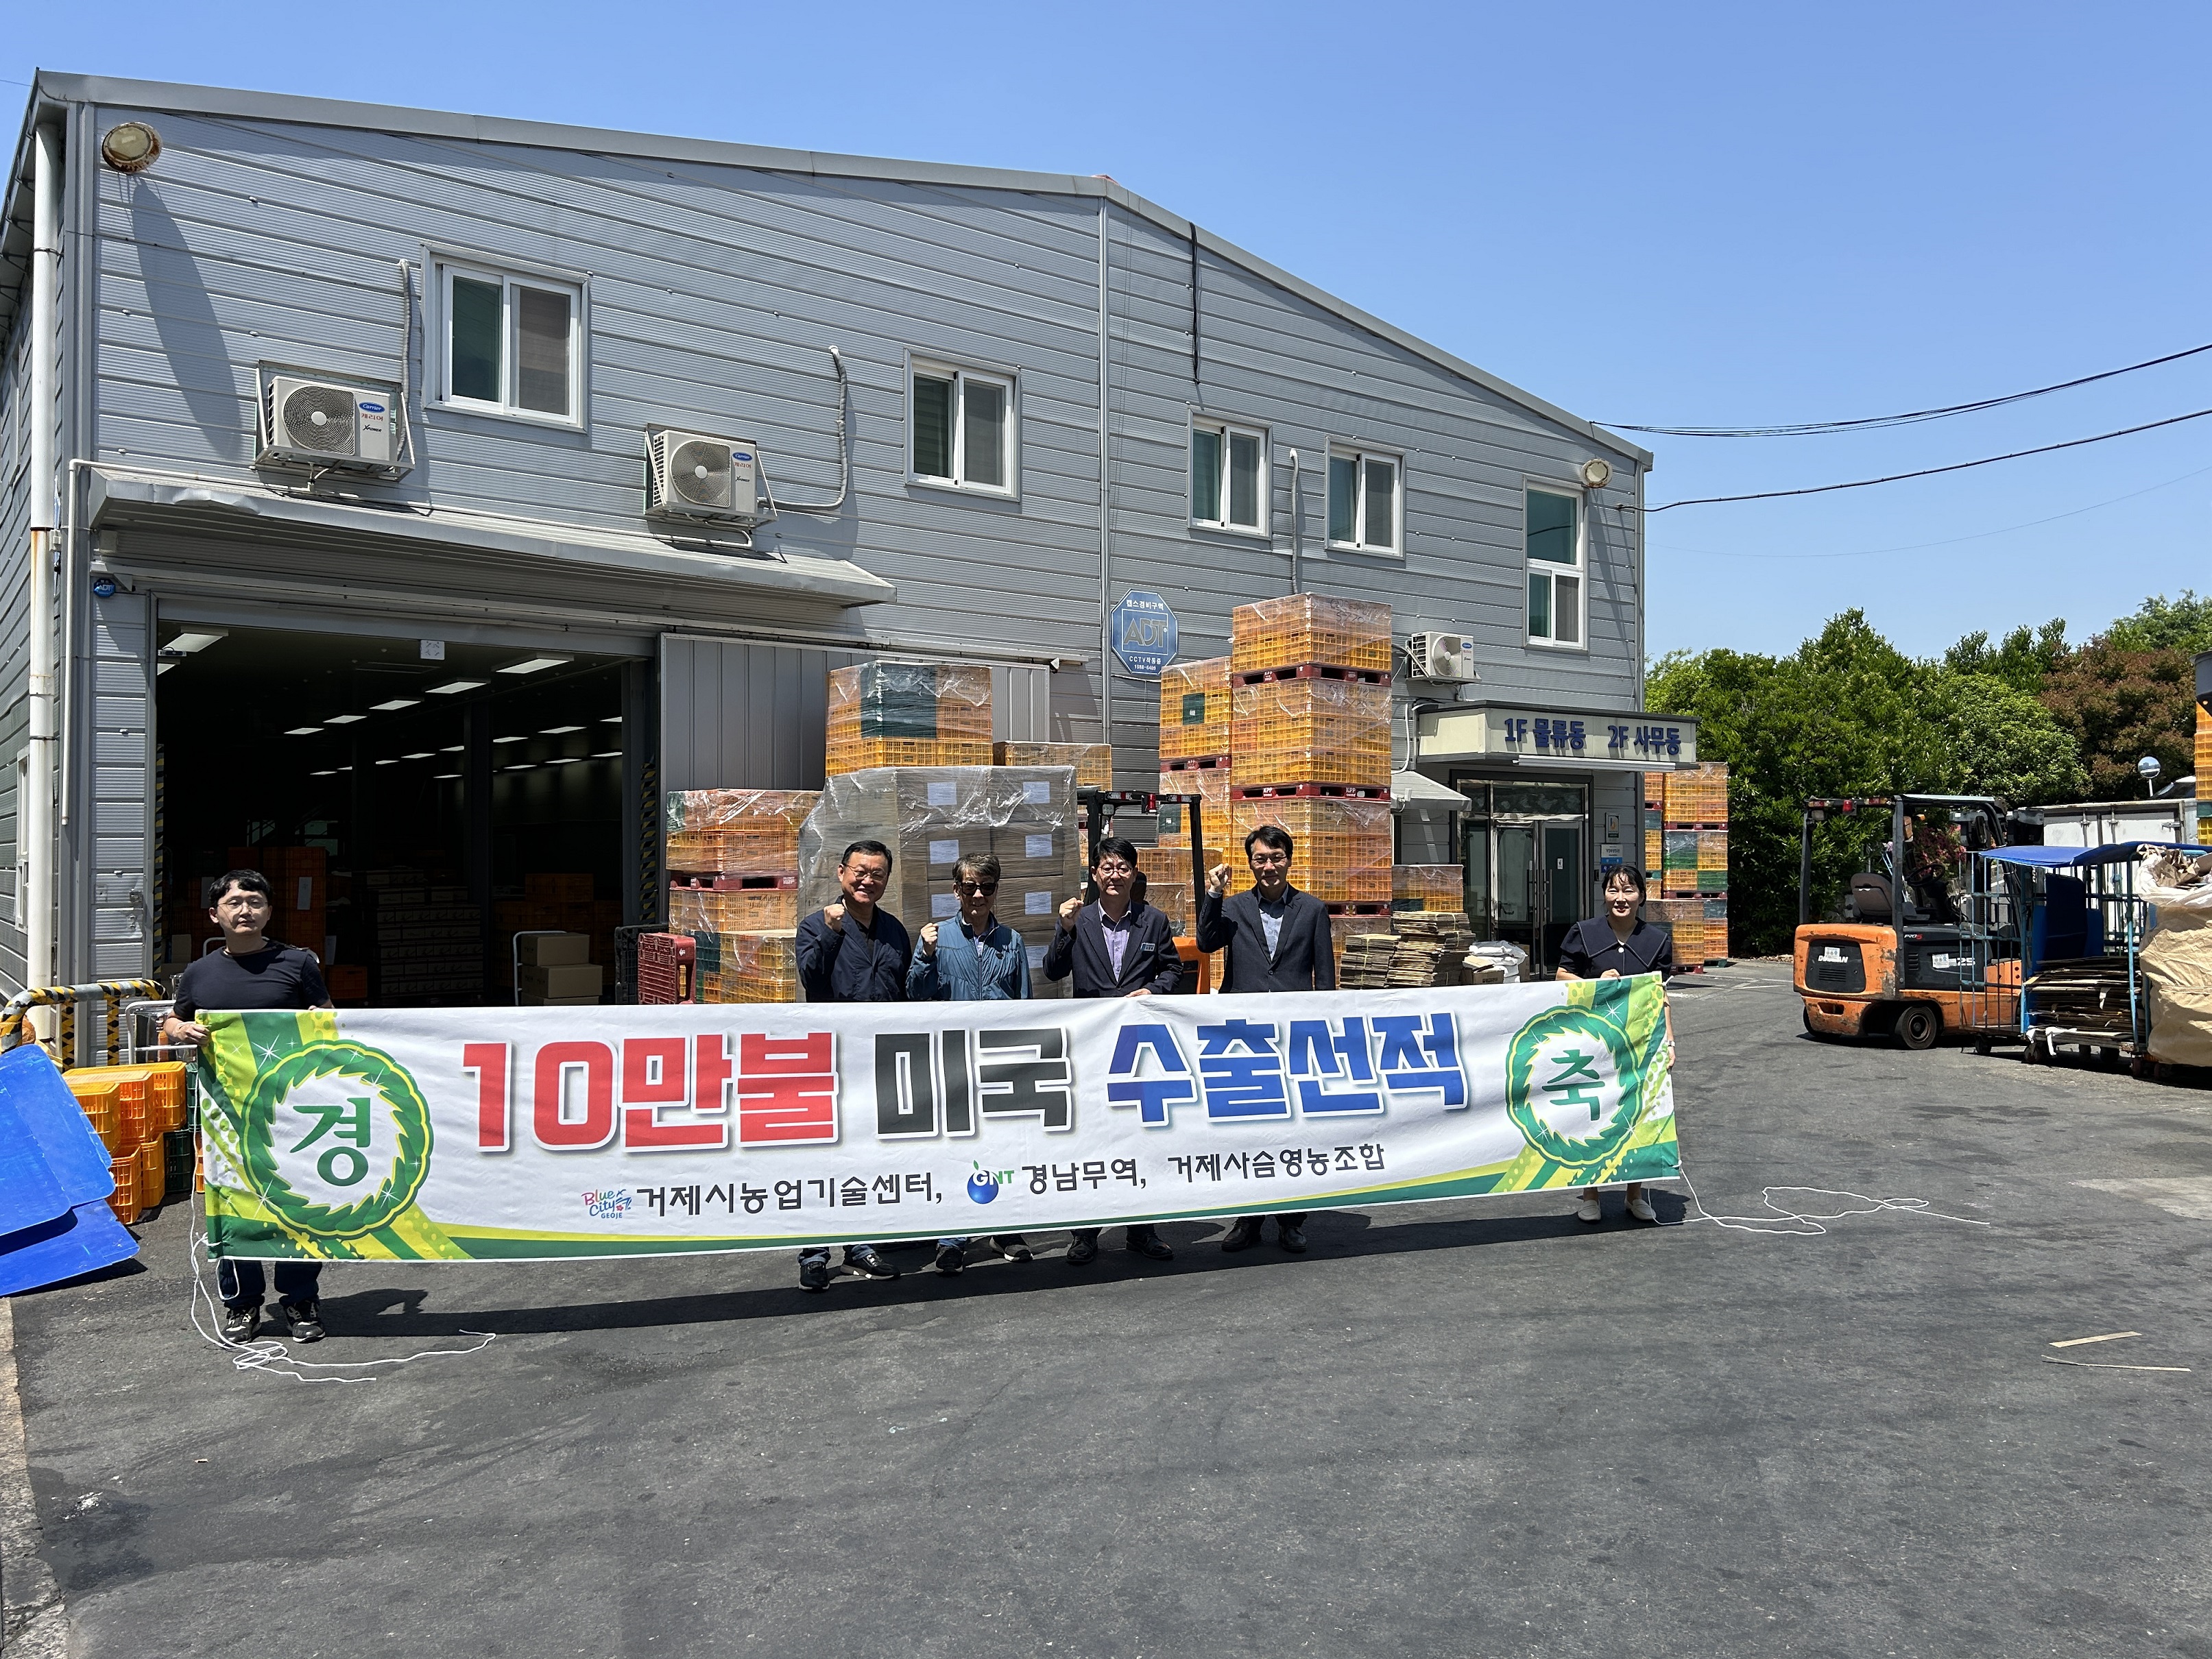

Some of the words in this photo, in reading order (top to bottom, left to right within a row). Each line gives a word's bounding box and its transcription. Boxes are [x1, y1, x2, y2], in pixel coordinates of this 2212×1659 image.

[361, 413, 383, 422] 캐리어
[1123, 618, 1166, 648] ADT
[1504, 718, 1527, 742] 1F
[1532, 718, 1586, 749] 물류동
[1607, 725, 1628, 749] 2F
[1633, 725, 1681, 755] 사무동
[462, 1031, 837, 1150] 10만불
[874, 1026, 1070, 1138] 미국
[1106, 1012, 1467, 1126] 수출선적
[1541, 1048, 1604, 1122] 축
[289, 1097, 371, 1187] 경
[581, 1189, 615, 1205] Blue
[636, 1172, 942, 1217] 거제시농업기술센터,
[972, 1170, 1015, 1187] GNT
[1022, 1159, 1146, 1194] 경남무역,
[1168, 1143, 1384, 1183] 거제사슴영농조합
[589, 1200, 615, 1216] City
